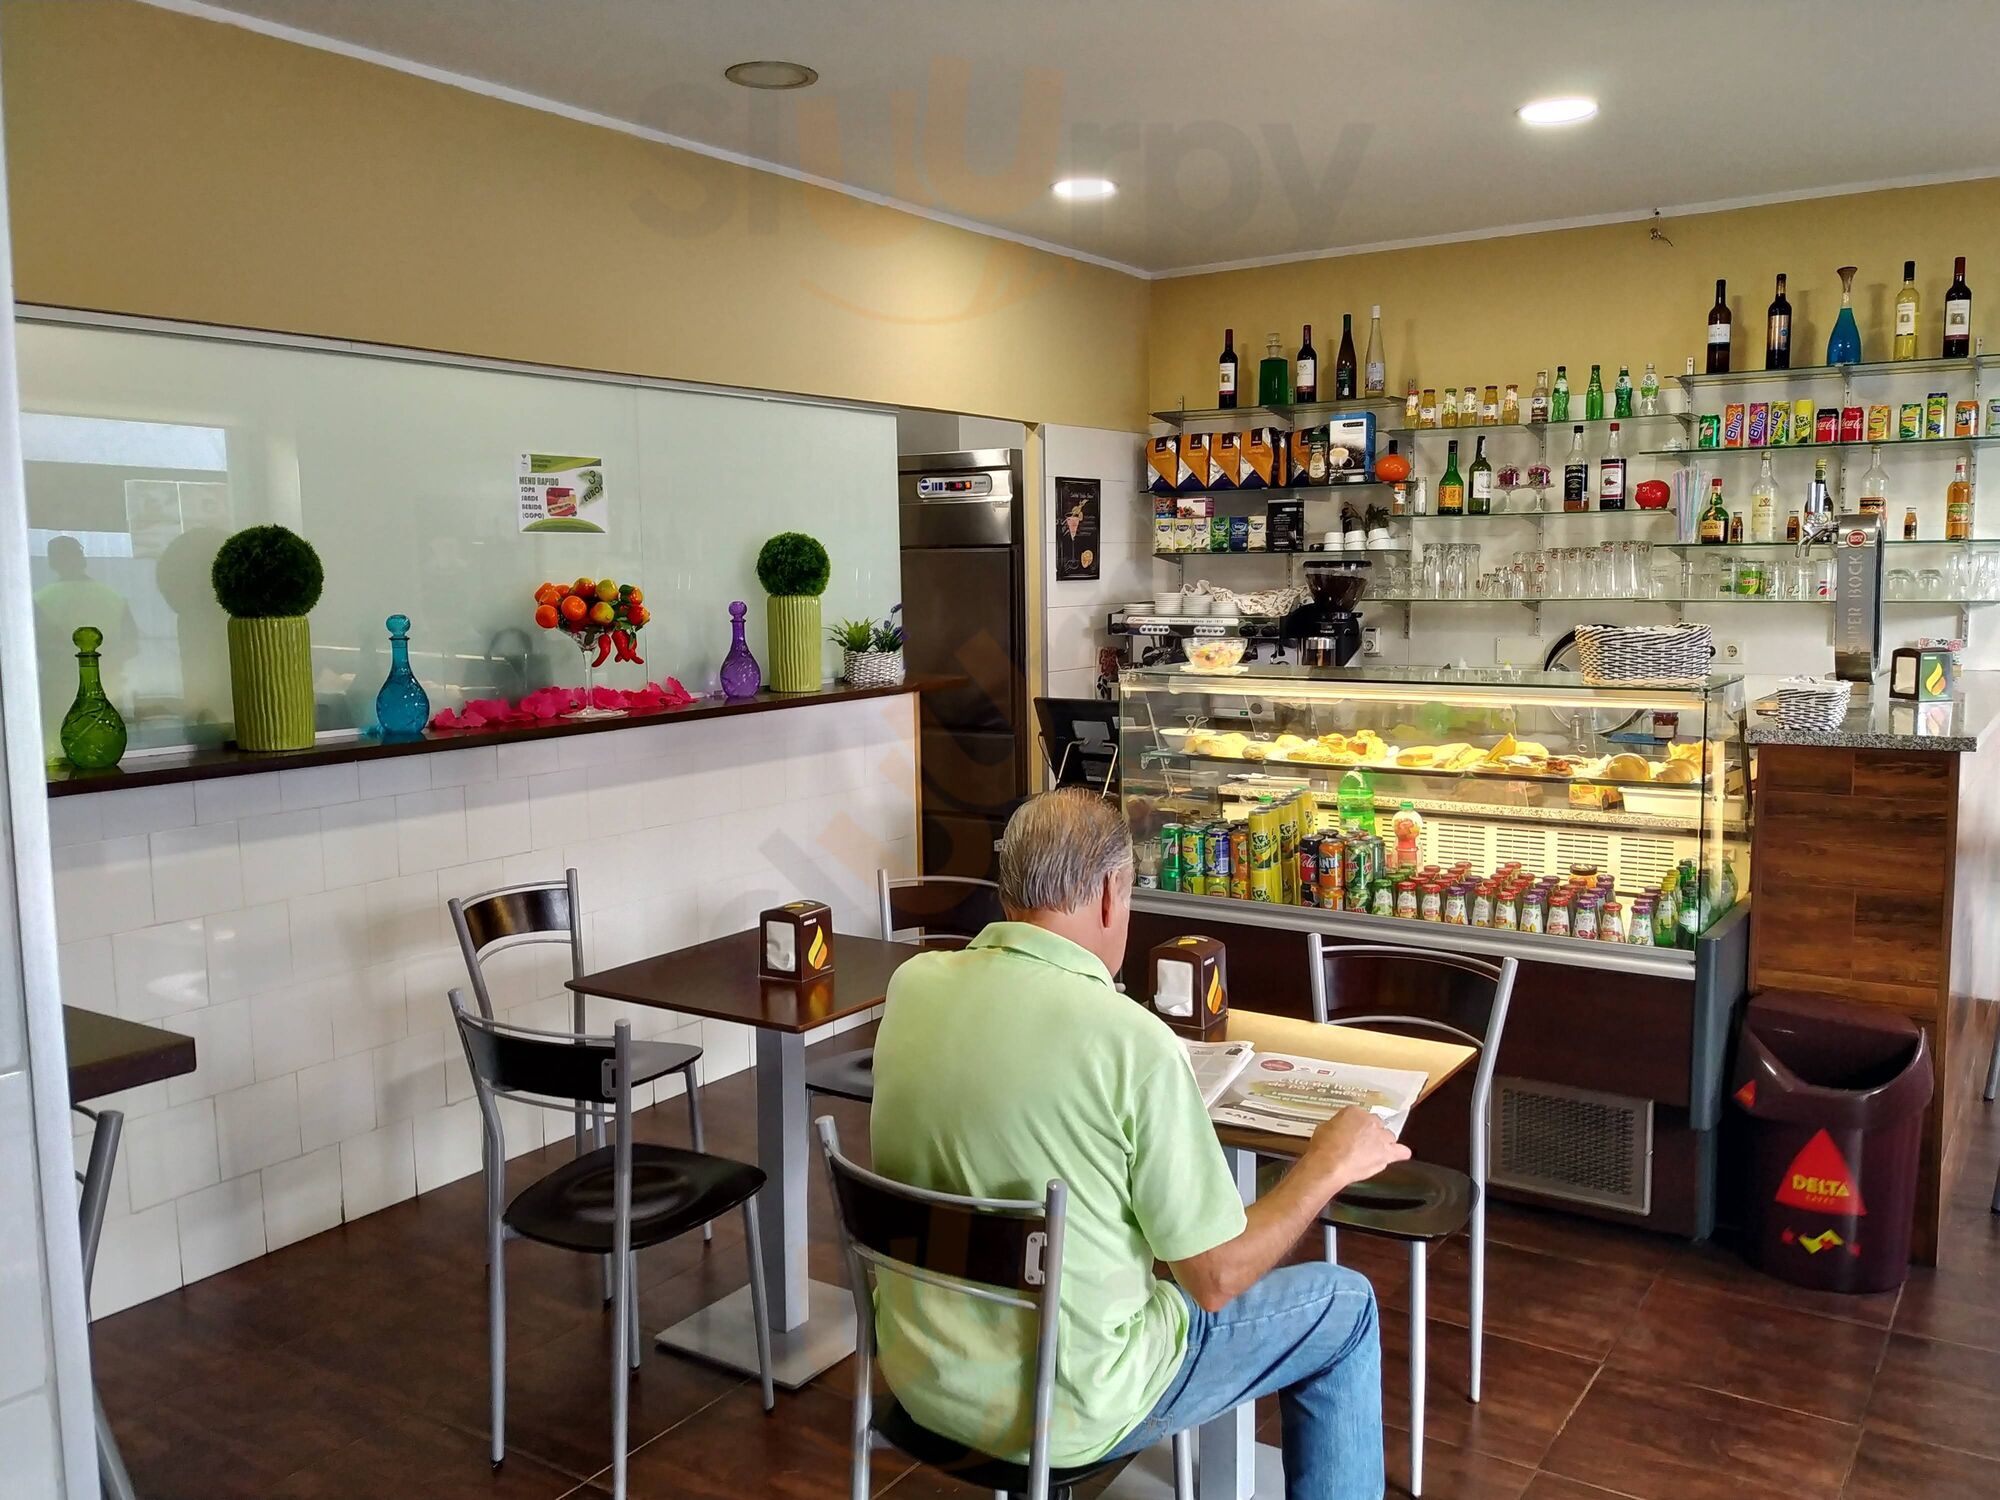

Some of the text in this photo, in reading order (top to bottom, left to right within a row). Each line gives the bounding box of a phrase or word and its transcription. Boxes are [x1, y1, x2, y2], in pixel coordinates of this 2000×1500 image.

[1726, 412, 1743, 439] Blue
[1749, 411, 1766, 438] Blue
[519, 476, 536, 486] MENU
[588, 470, 597, 485] 3
[583, 484, 604, 503] EUROS
[1847, 555, 1864, 655] SUPER BOCK
[1792, 1173, 1851, 1197] DELTA
